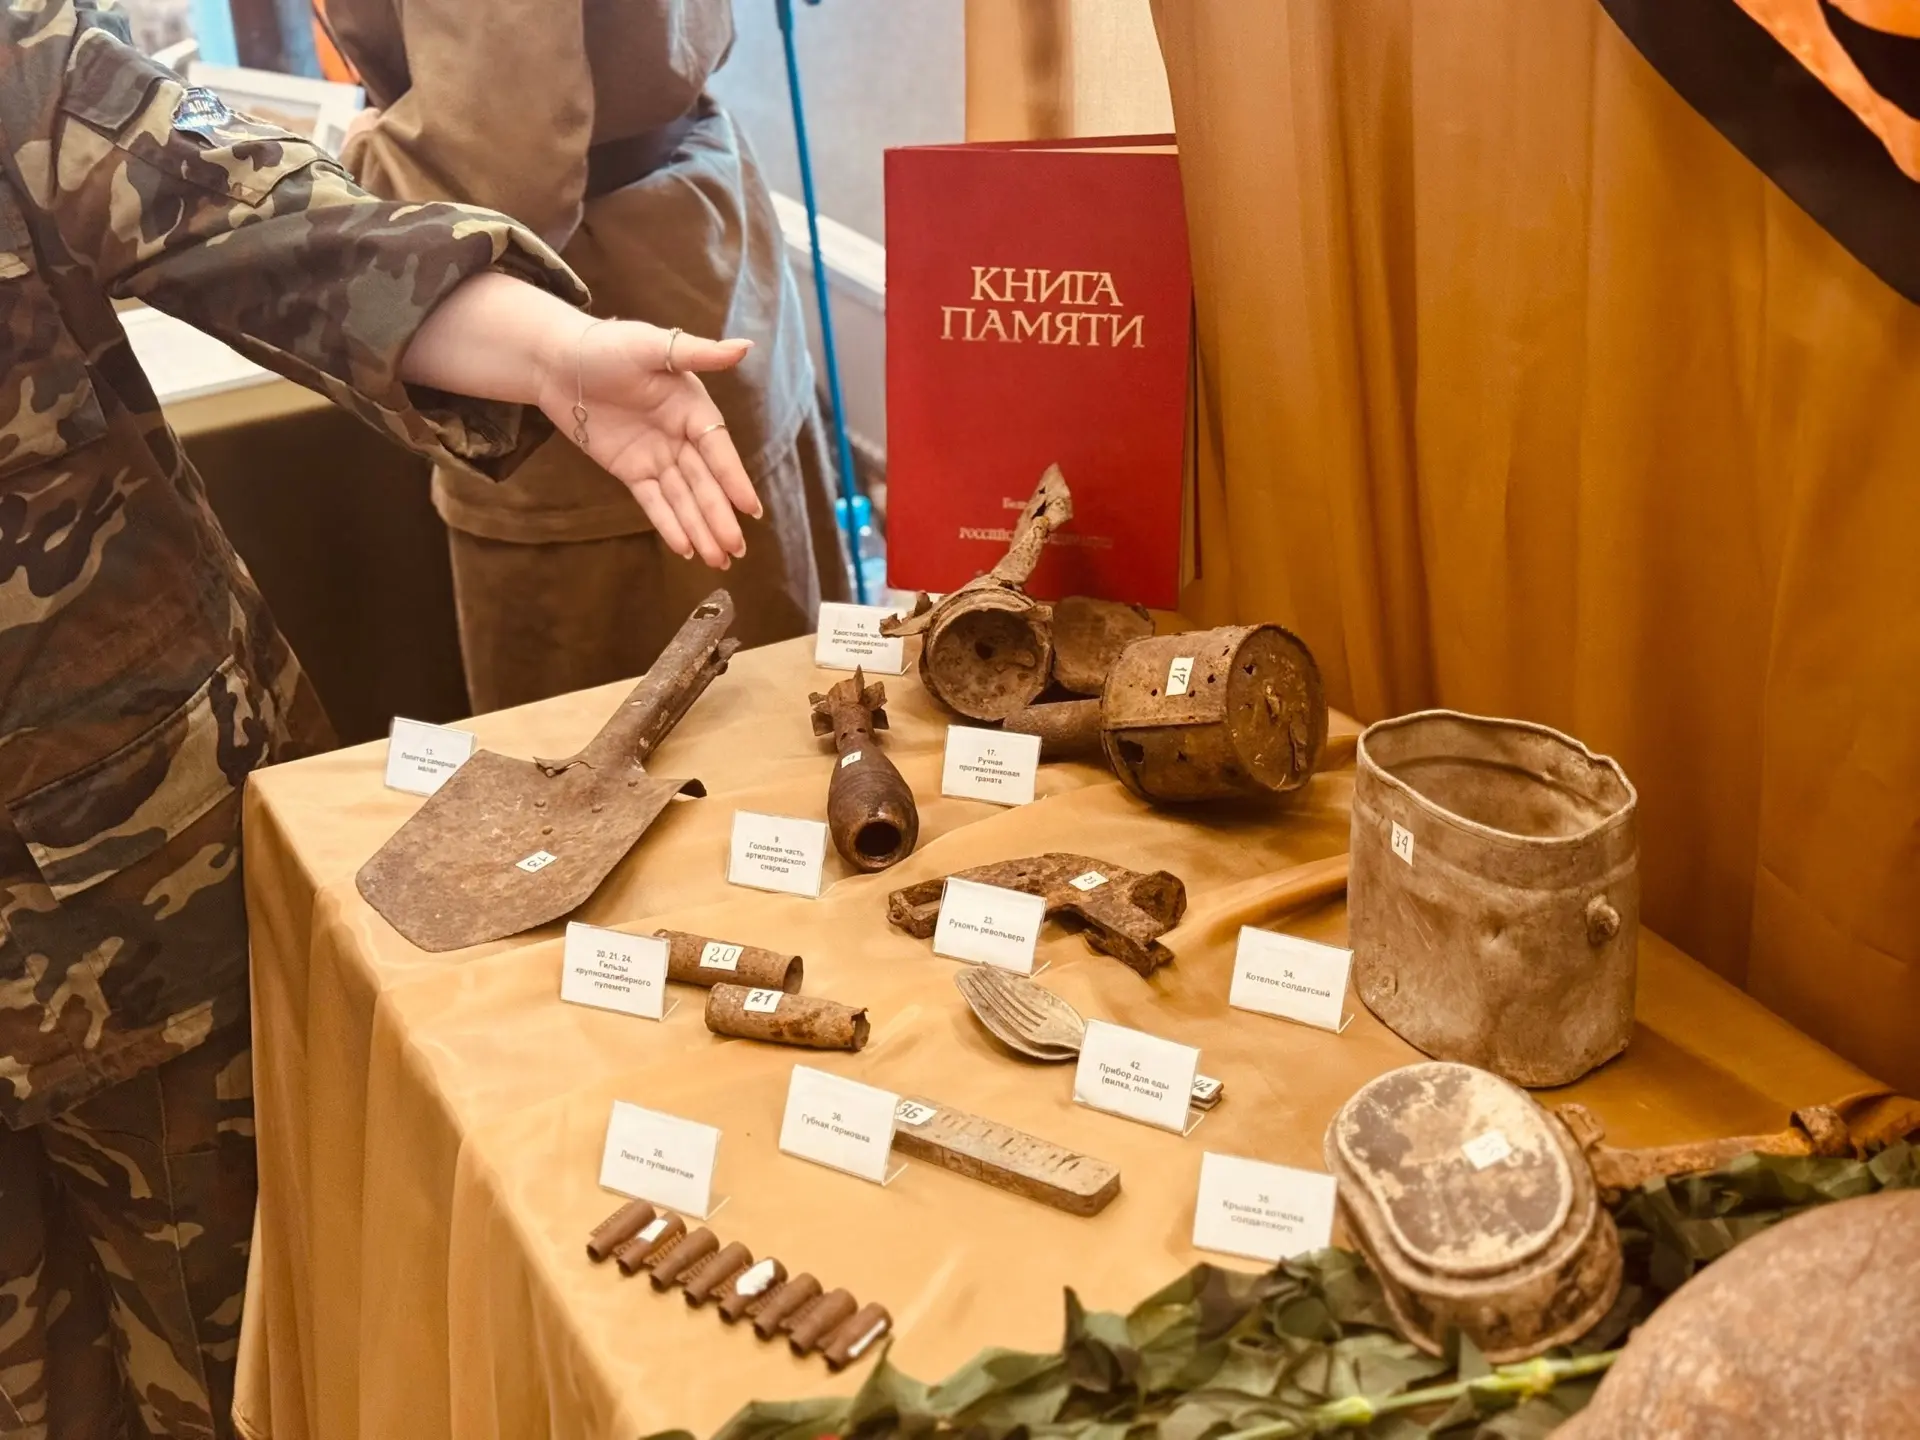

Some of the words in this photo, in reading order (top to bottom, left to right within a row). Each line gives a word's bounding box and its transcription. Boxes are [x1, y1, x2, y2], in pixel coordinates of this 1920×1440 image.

[970, 266, 1123, 306] КНИГА
[940, 305, 1145, 348] ПАМЯТИ
[832, 629, 868, 638] Хвостовая
[831, 638, 889, 648] артиллерийского
[845, 647, 873, 655] снаряда
[1172, 667, 1187, 685] 17
[977, 756, 1003, 766] Ручная
[959, 764, 1021, 778] противотанковая
[975, 775, 1003, 785] граната
[748, 841, 783, 853] Головная
[784, 848, 805, 857] часть
[745, 851, 807, 867] артиллерийского
[760, 863, 790, 874] снаряда
[948, 918, 979, 932] Рукоять
[980, 926, 1026, 943] револьвера
[596, 949, 607, 959] 20.
[609, 952, 620, 961] 21.
[621, 954, 633, 964] 24.
[708, 946, 737, 963] 20
[599, 960, 629, 973] Гильзы
[1283, 969, 1296, 979] 34.
[575, 966, 651, 987] крупнокалиберного
[1245, 971, 1280, 987] Котелок
[1281, 981, 1331, 998] солдатский
[594, 980, 631, 993] пулемета
[750, 991, 775, 1006] 21
[1130, 1060, 1142, 1071] 42.
[1099, 1063, 1132, 1080] Прибор
[1132, 1075, 1150, 1085] для
[1151, 1079, 1170, 1090] еды
[1101, 1075, 1132, 1092] (вилка,
[1133, 1085, 1164, 1100] ложка)
[801, 1113, 830, 1130] Губная
[830, 1124, 871, 1143] гармошка
[620, 1149, 645, 1164] Лента
[646, 1158, 695, 1180] пулеметная
[1222, 1199, 1263, 1215] Крышка
[1264, 1209, 1305, 1224] котелка
[1230, 1214, 1294, 1234] солдатского
